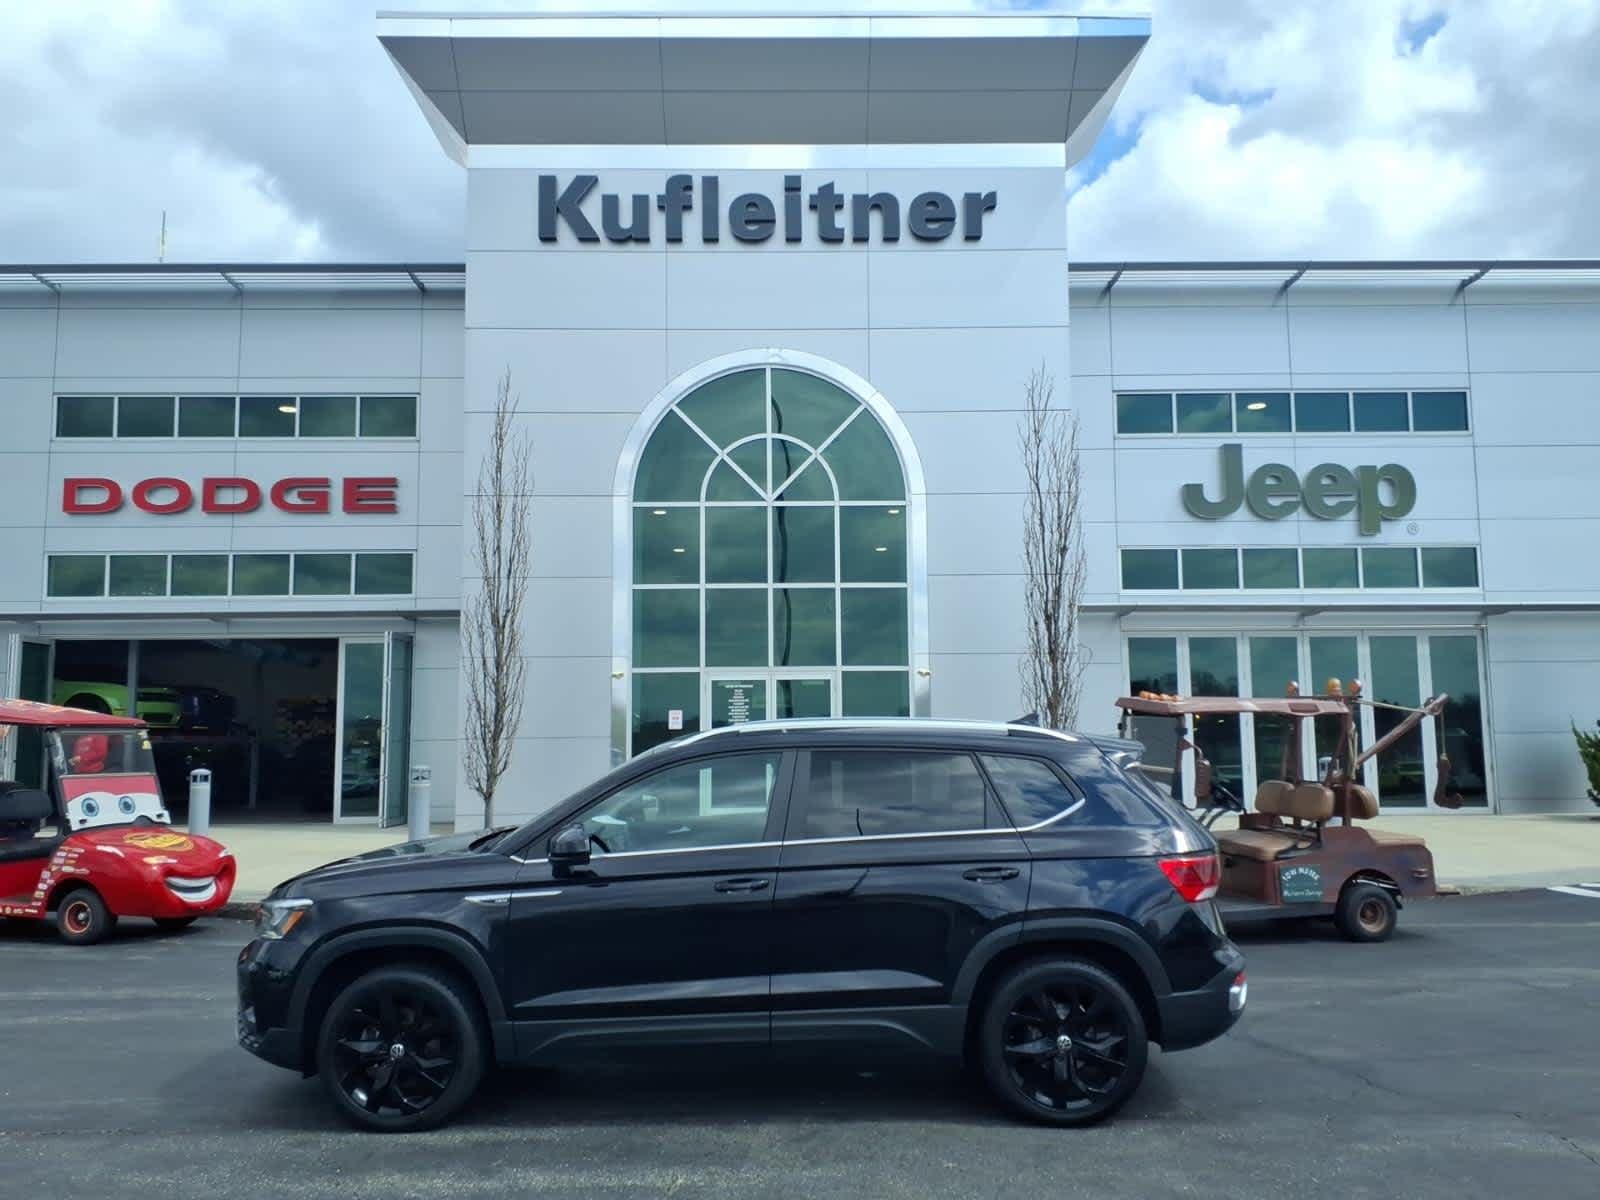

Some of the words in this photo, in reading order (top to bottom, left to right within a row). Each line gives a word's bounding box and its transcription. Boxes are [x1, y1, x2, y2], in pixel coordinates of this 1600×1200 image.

[538, 174, 997, 243] Kufleitner
[62, 477, 398, 514] DODGE
[1182, 443, 1417, 536] Jeep
